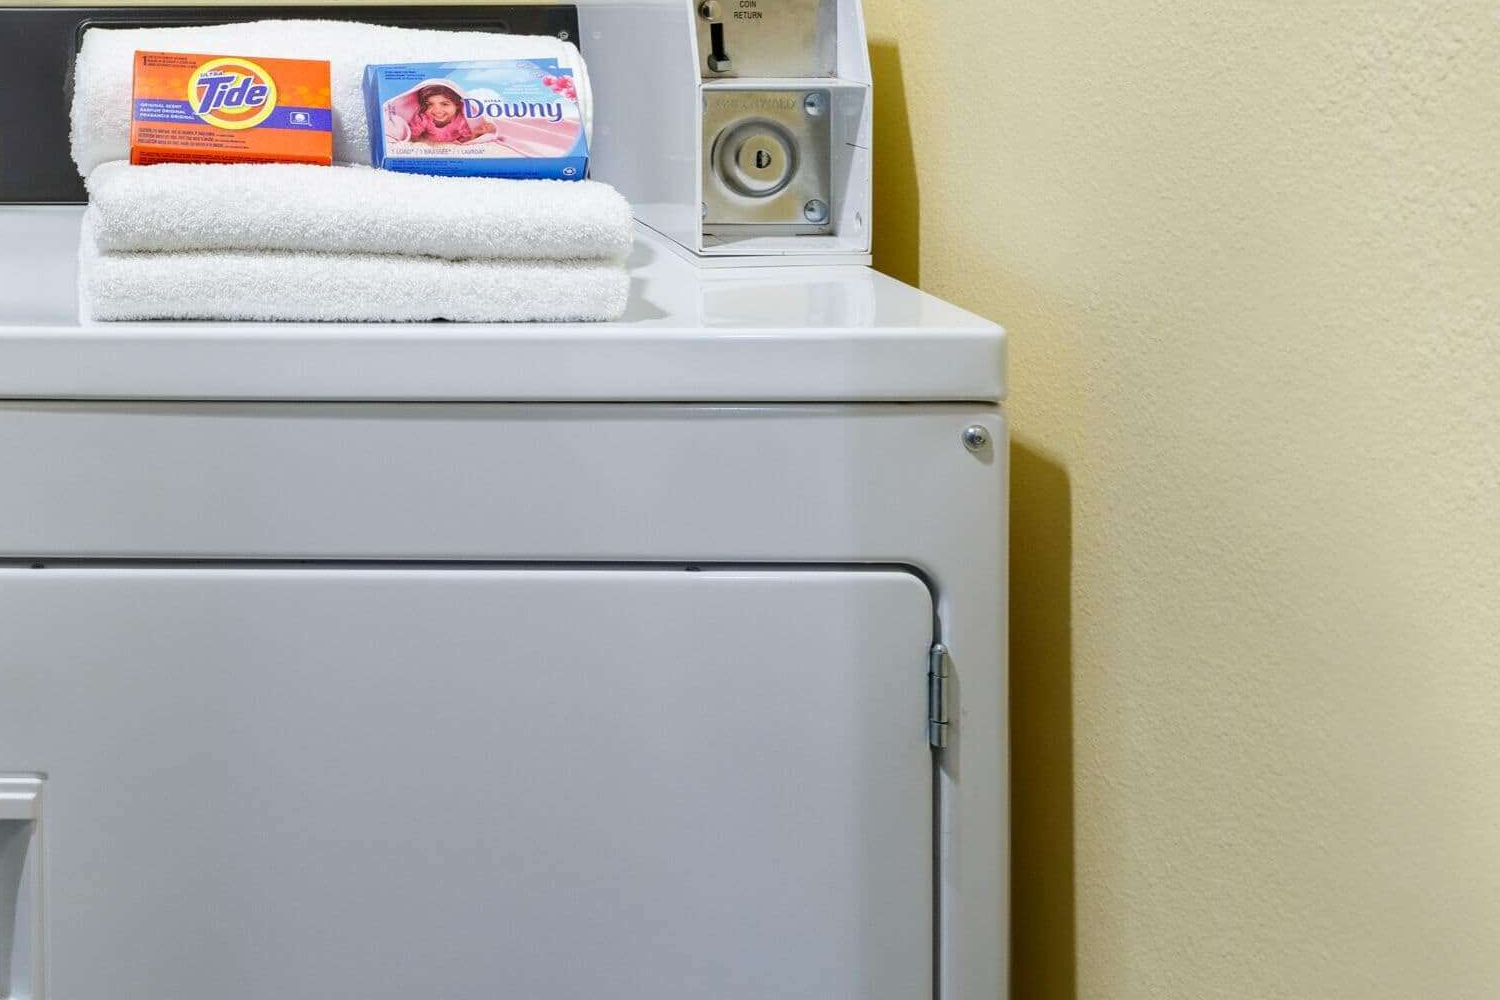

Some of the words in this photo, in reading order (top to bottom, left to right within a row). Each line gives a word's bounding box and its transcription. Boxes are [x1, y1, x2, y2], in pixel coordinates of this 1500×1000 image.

[739, 0, 757, 8] COIN
[733, 11, 763, 19] RETURN
[196, 75, 269, 115] Tide
[463, 98, 563, 123] Downy
